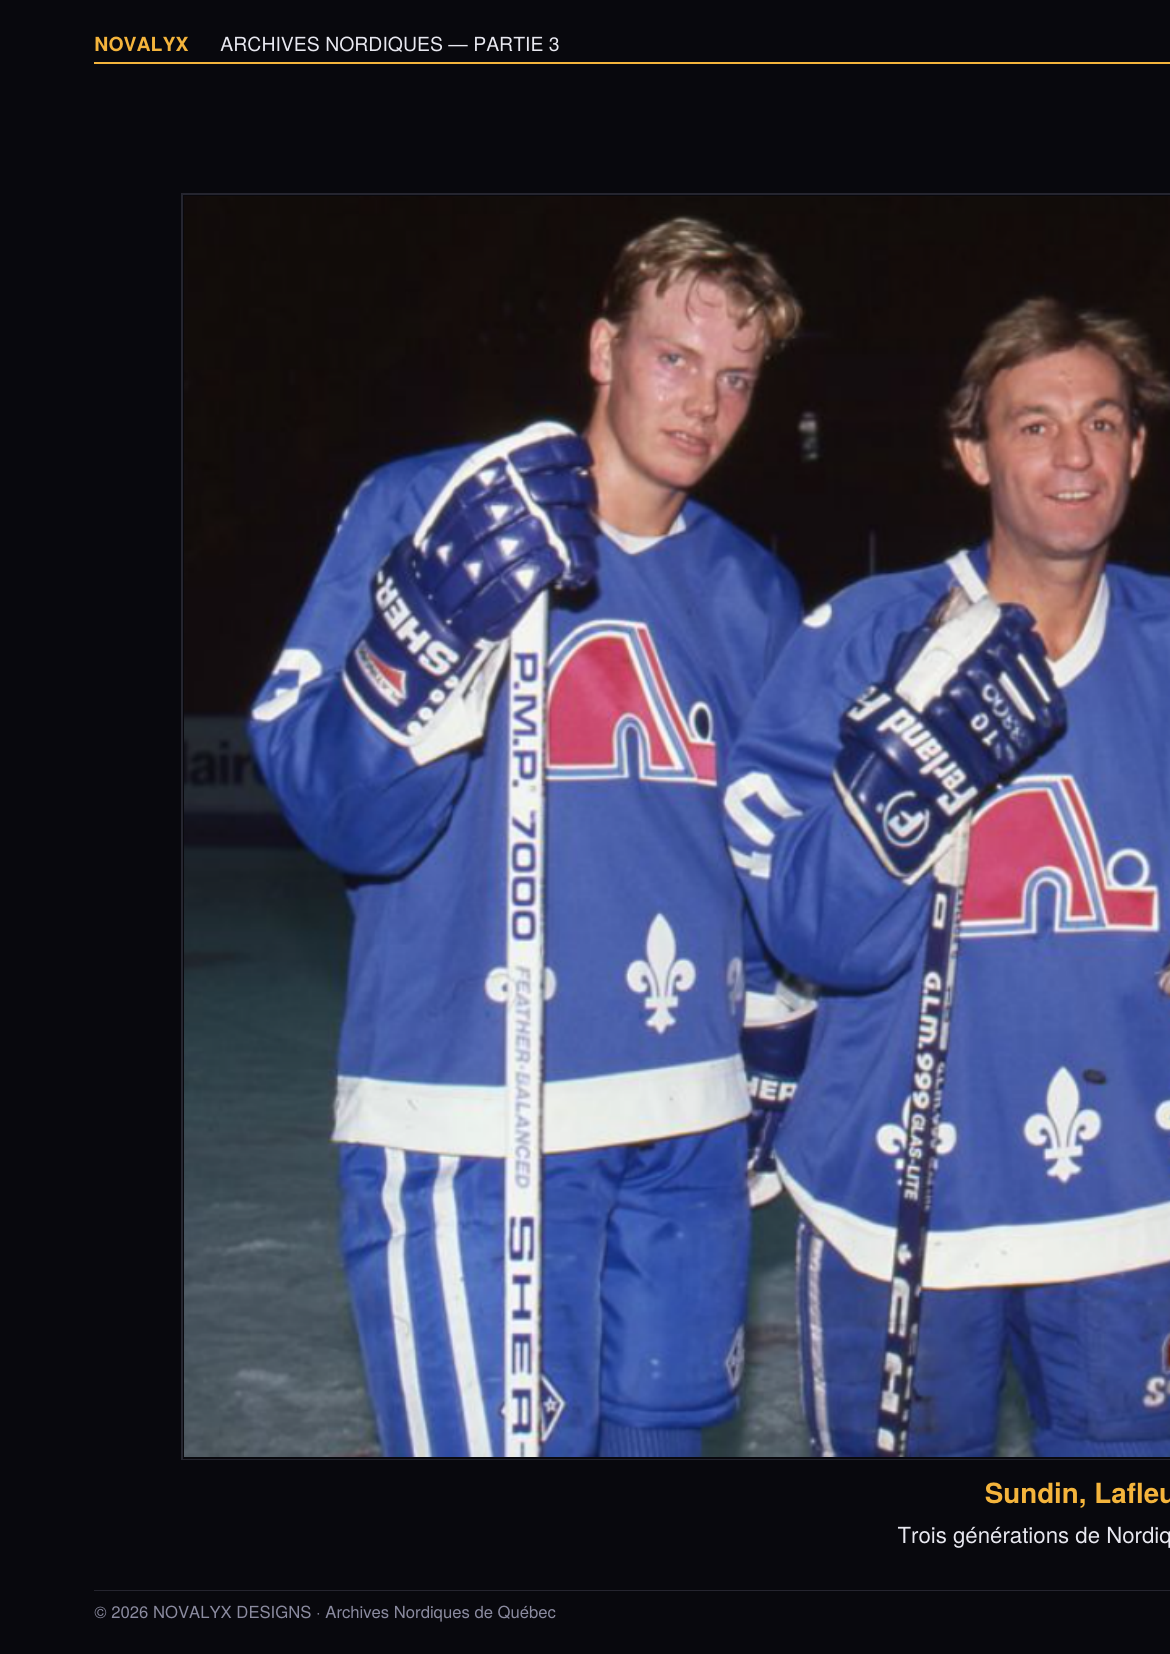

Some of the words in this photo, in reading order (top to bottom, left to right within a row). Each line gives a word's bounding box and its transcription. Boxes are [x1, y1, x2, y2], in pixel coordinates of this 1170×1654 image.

[512, 652, 538, 788] P.M.P.
[876, 707, 978, 816] Ferland
[511, 810, 538, 941] 7000
[917, 971, 942, 1048] G.L.M.
[514, 966, 531, 1189] FEATHER-BALANCED
[911, 1052, 933, 1110] 999
[904, 1113, 925, 1202] GLAS-LITE
